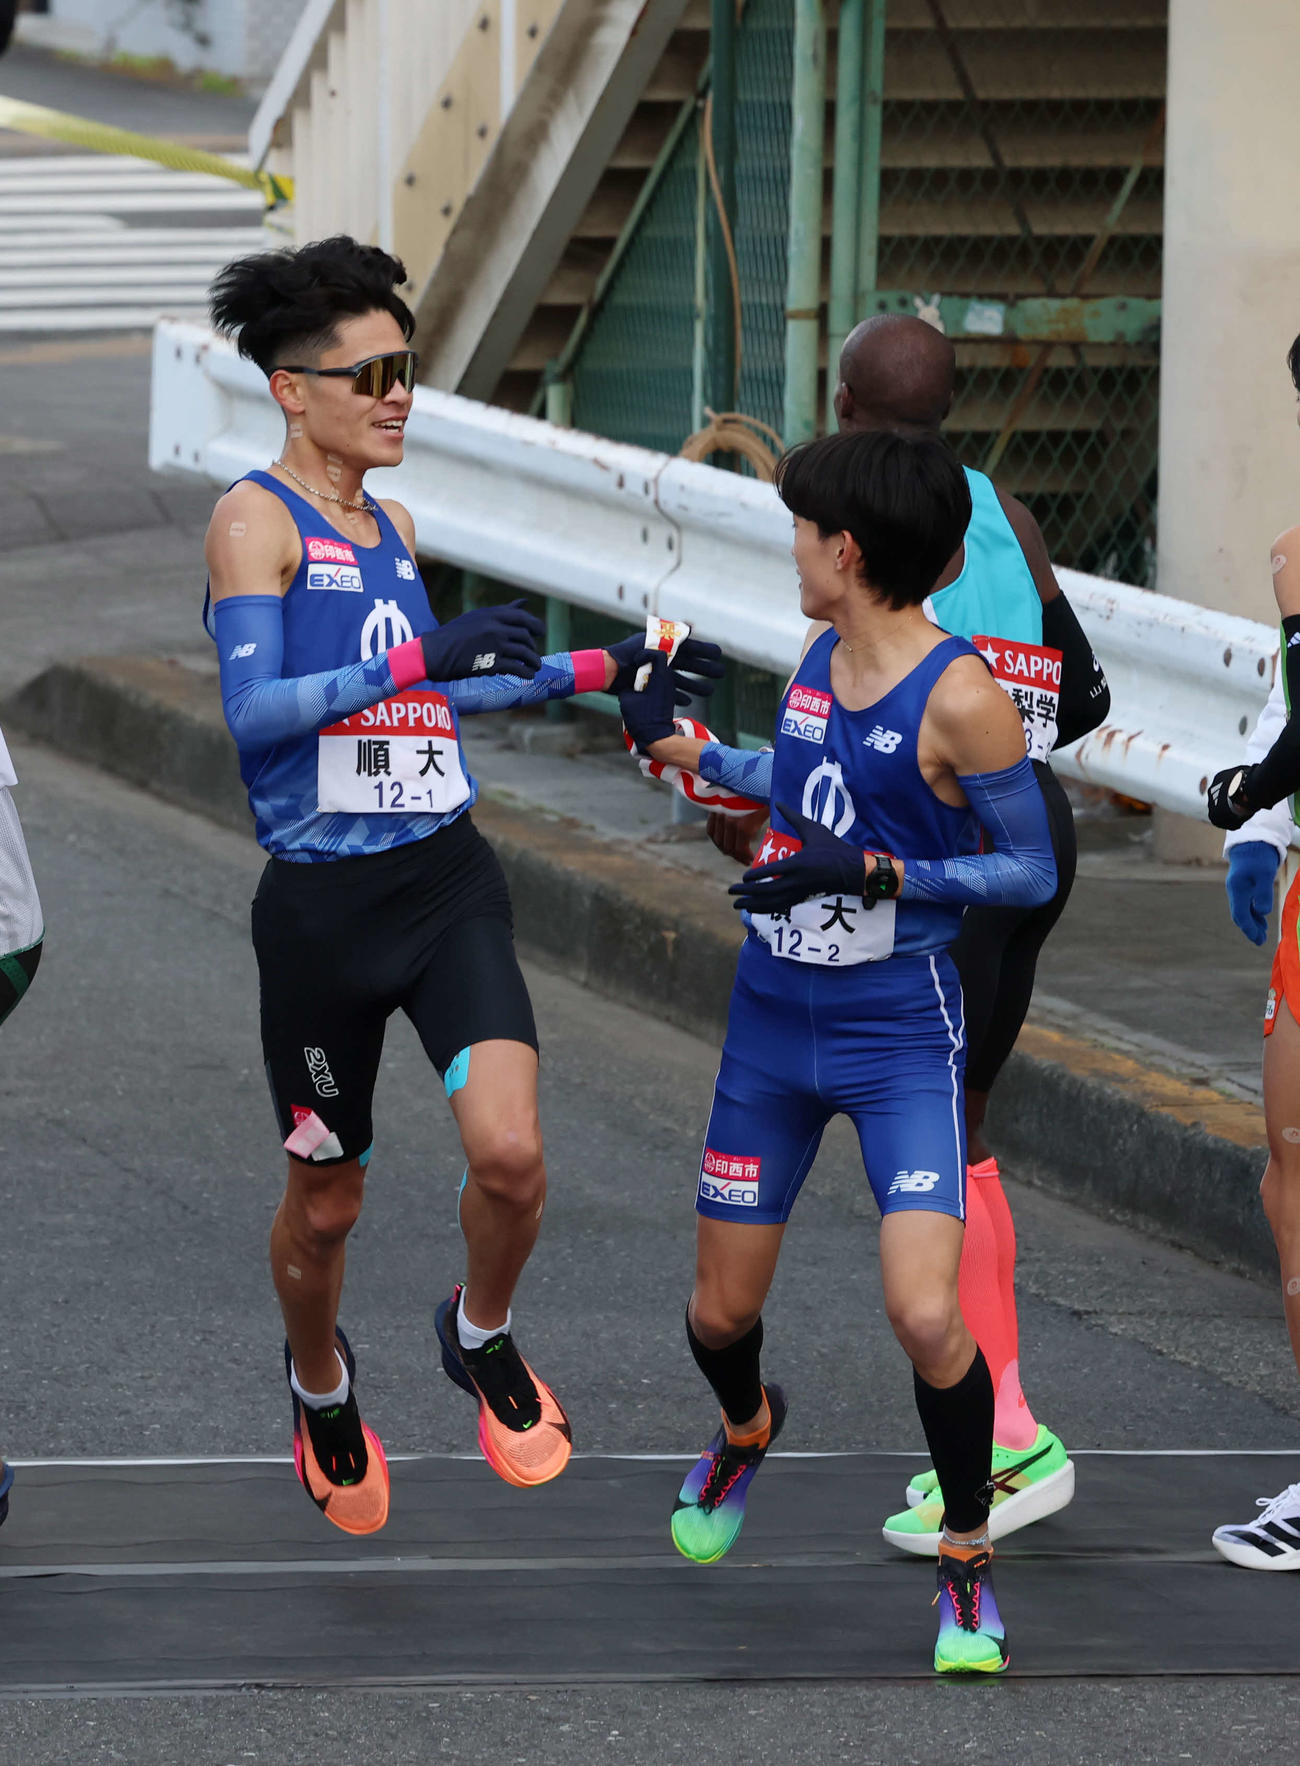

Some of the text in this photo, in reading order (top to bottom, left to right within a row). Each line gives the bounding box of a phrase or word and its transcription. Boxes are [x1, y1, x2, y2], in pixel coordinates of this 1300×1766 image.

[309, 567, 362, 590] EXEO
[360, 701, 451, 731] SAPPORO
[800, 693, 831, 715] 印西市
[783, 716, 824, 742] EXEO
[374, 781, 433, 809] 12-1
[774, 926, 840, 962] 12-2
[304, 1047, 339, 1097] 2XU
[715, 1159, 759, 1178] 印西市
[702, 1181, 757, 1204] EXEO
